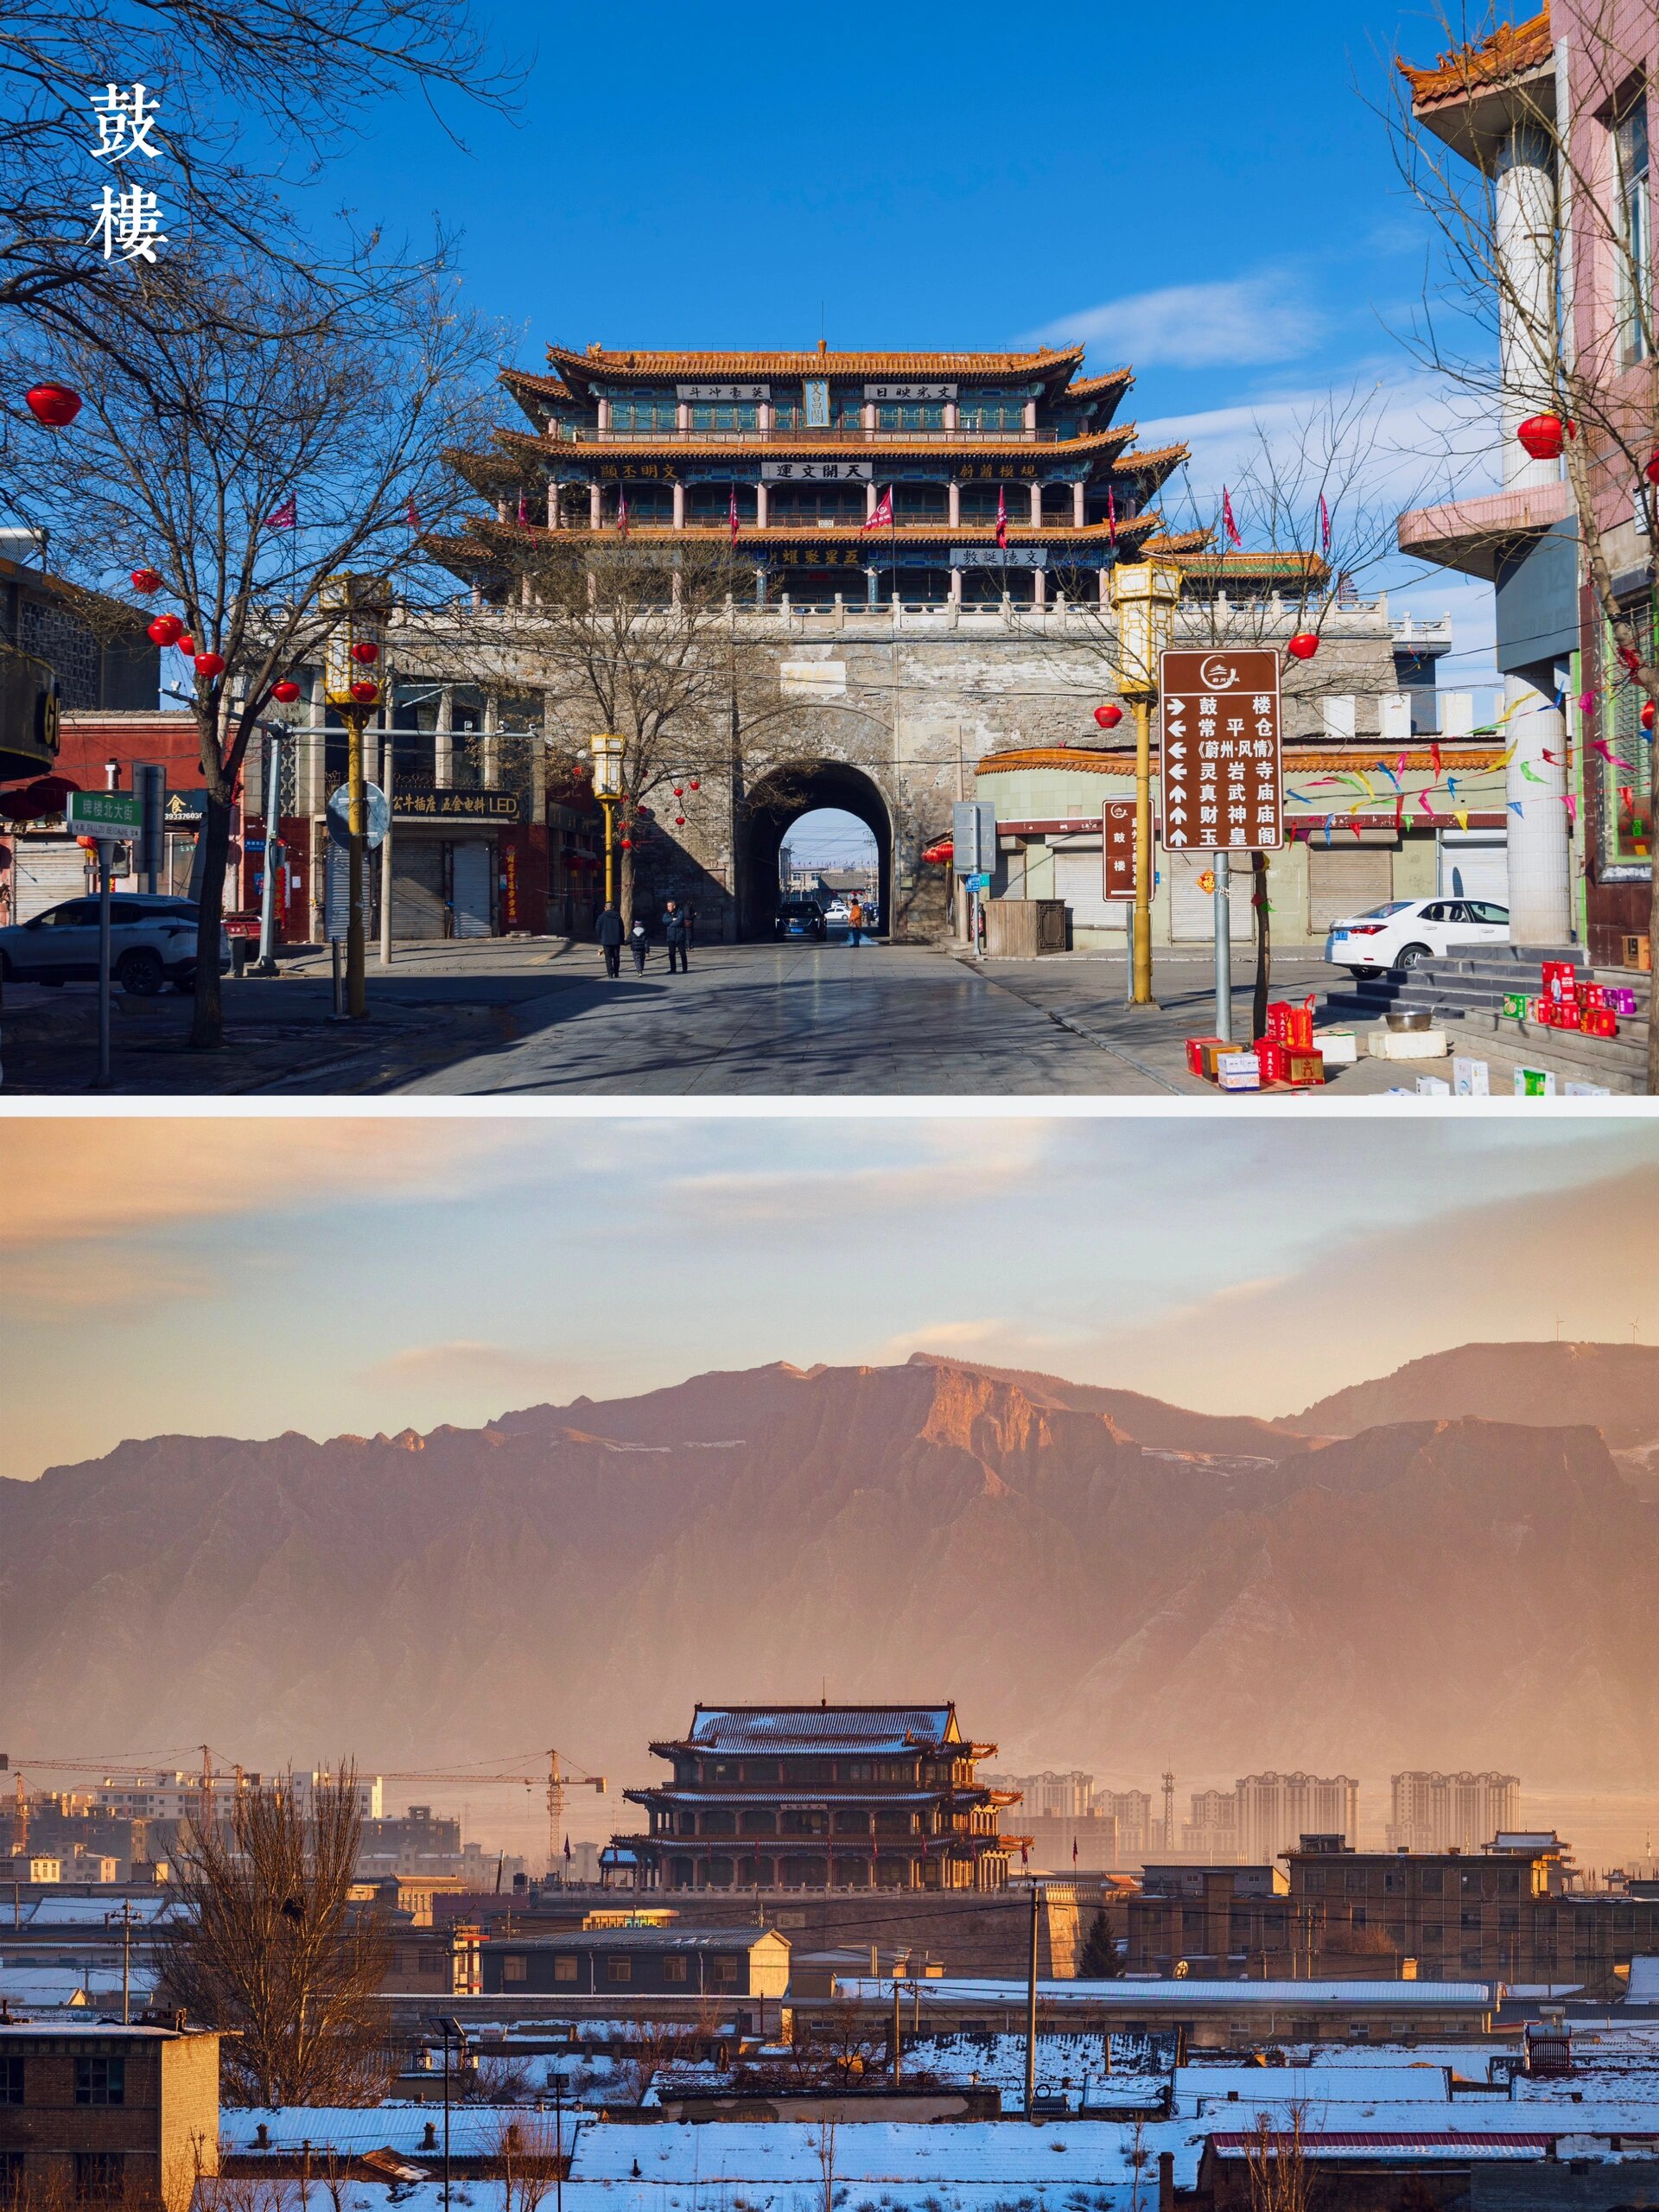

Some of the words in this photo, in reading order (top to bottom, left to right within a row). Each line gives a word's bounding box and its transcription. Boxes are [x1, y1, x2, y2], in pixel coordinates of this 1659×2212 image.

[1199, 696, 1271, 715] 鼓楼
[1198, 717, 1274, 737] 常平仓
[1199, 760, 1274, 781] 灵岩寺
[1199, 783, 1274, 802] 真武庙
[82, 798, 133, 821] 牌楼北大街
[489, 797, 517, 813] LED
[1199, 804, 1275, 824] 财神庙
[1199, 827, 1276, 846] 玉皇阁
